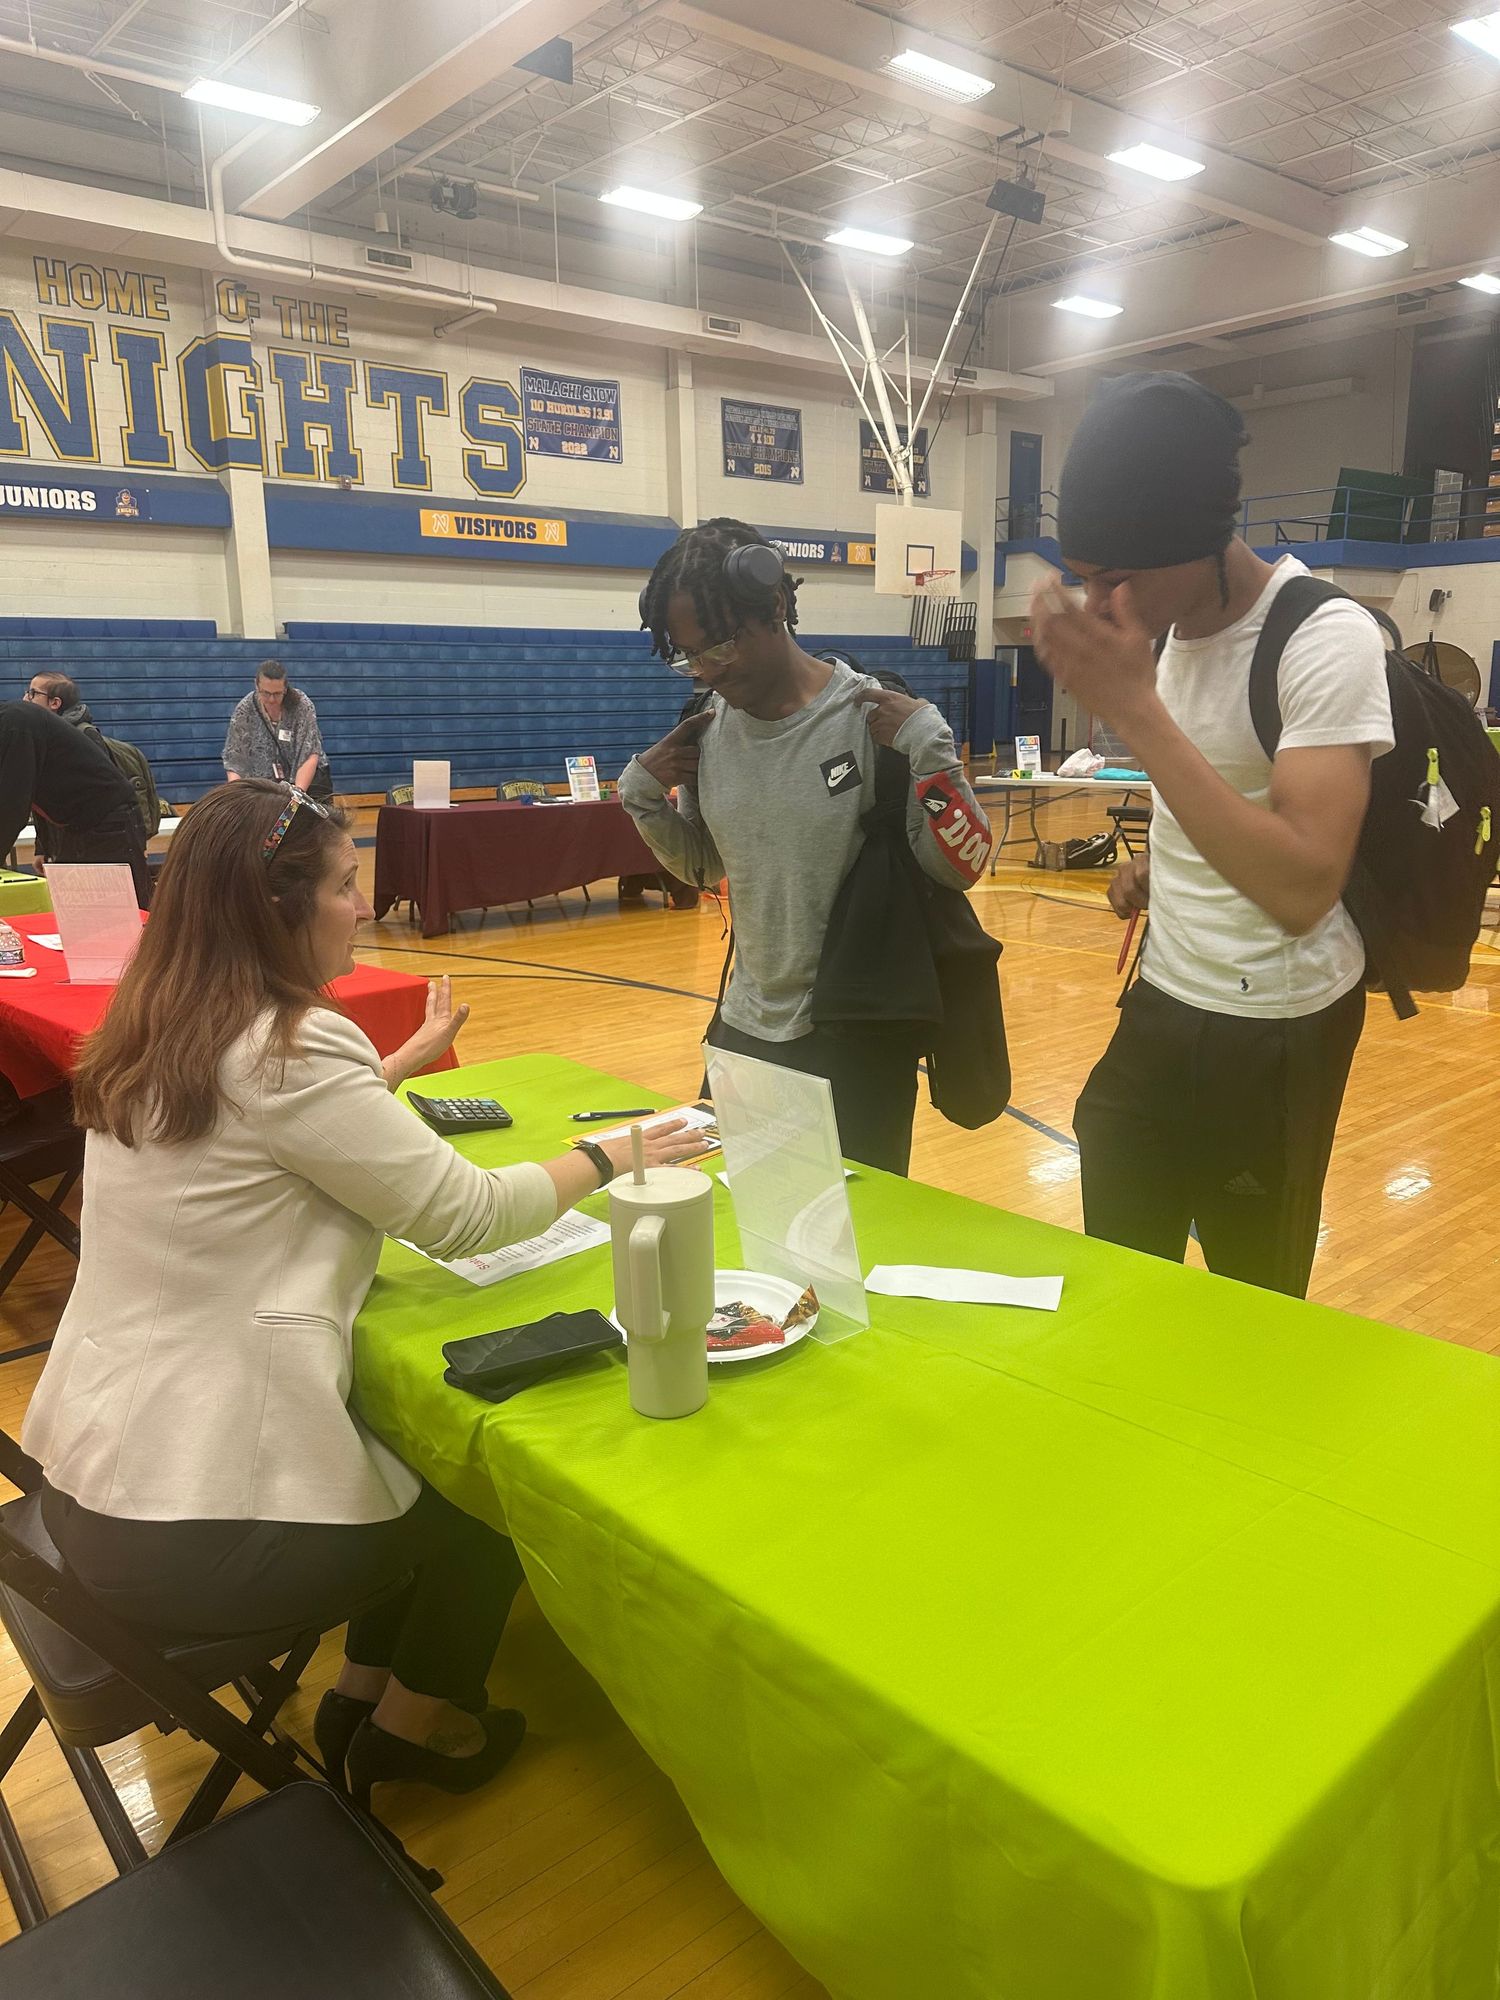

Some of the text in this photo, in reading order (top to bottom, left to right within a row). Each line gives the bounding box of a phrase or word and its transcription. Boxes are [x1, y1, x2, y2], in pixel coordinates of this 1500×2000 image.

[33, 255, 350, 348] HOME OF THE
[524, 375, 617, 404] MALACHI SNOW
[546, 400, 591, 418] HURDLES
[527, 417, 618, 441] STATE CHAMPION
[561, 440, 588, 455] 2022
[454, 516, 537, 540] VISITORS
[830, 761, 849, 779] NIKE
